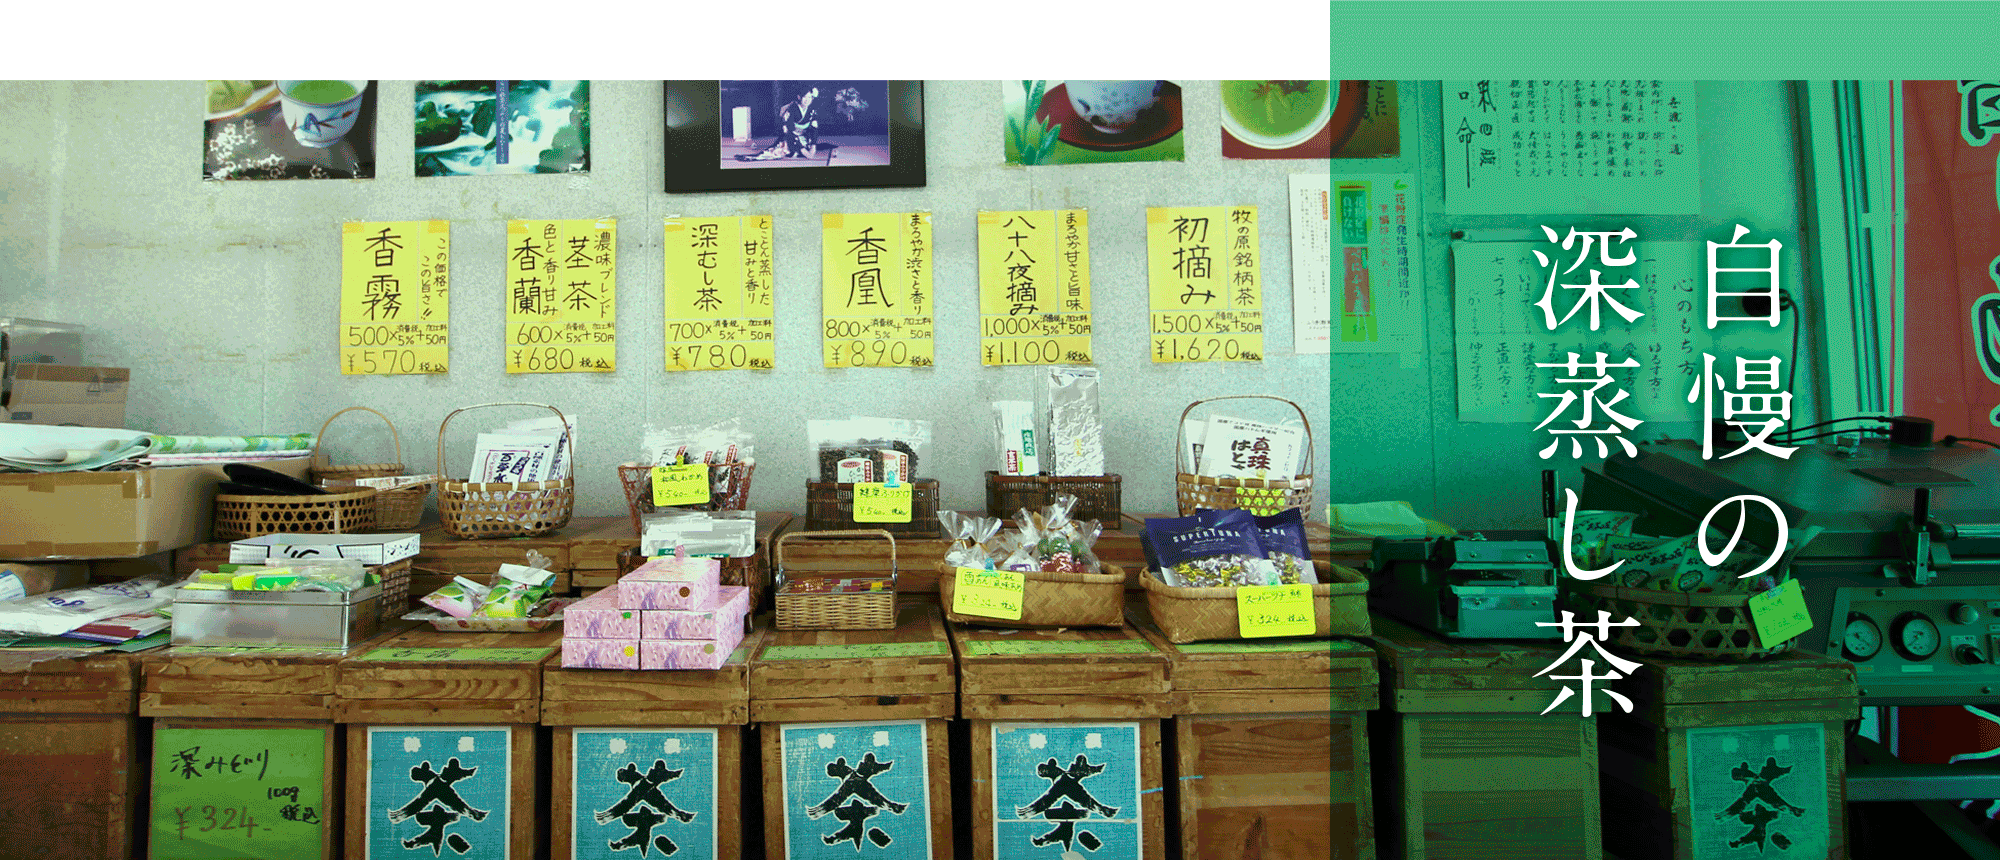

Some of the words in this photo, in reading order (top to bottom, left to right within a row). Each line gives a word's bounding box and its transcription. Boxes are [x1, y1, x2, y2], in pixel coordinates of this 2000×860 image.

[361, 227, 403, 322] 香霧
[691, 223, 724, 313] 深むし茶
[1002, 215, 1040, 317] 八十八夜摘み
[1167, 215, 1217, 306] 初摘み
[1231, 209, 1256, 306] 牧の原銘柄茶
[1249, 436, 1272, 471] 真珠
[1172, 527, 1242, 544] SUPERTUNA
[387, 756, 492, 858] 茶
[595, 757, 699, 859] 茶
[805, 752, 911, 853] 茶
[1014, 754, 1122, 854] 茶
[1713, 755, 1809, 855] 茶
